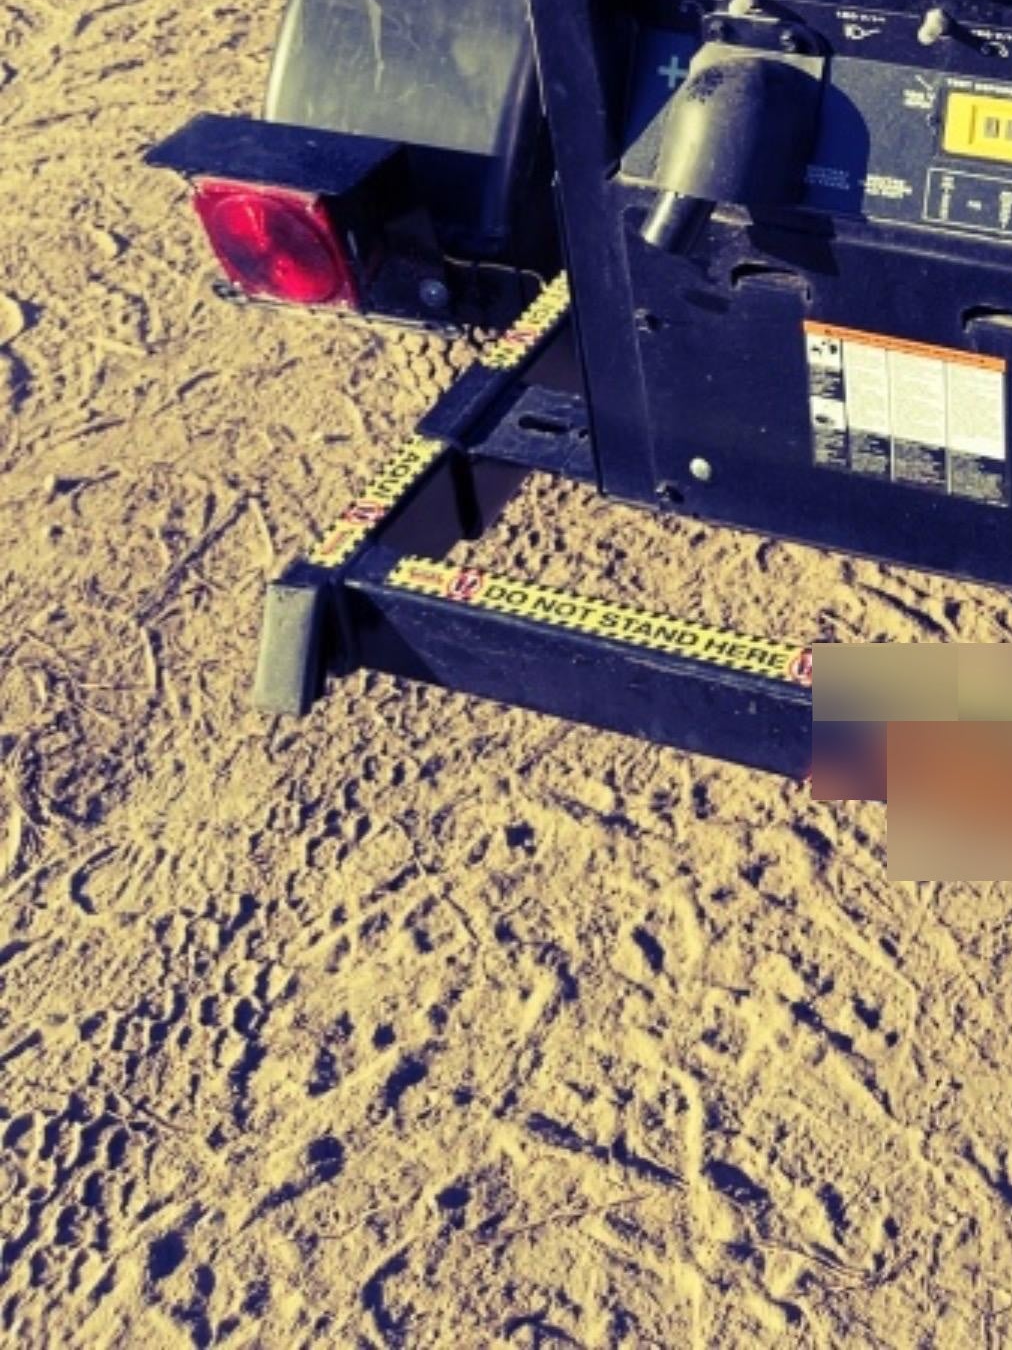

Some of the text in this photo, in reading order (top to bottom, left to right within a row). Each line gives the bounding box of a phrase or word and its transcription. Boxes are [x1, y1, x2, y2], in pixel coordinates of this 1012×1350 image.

[483, 582, 788, 669] DO NOT STAND HERE
